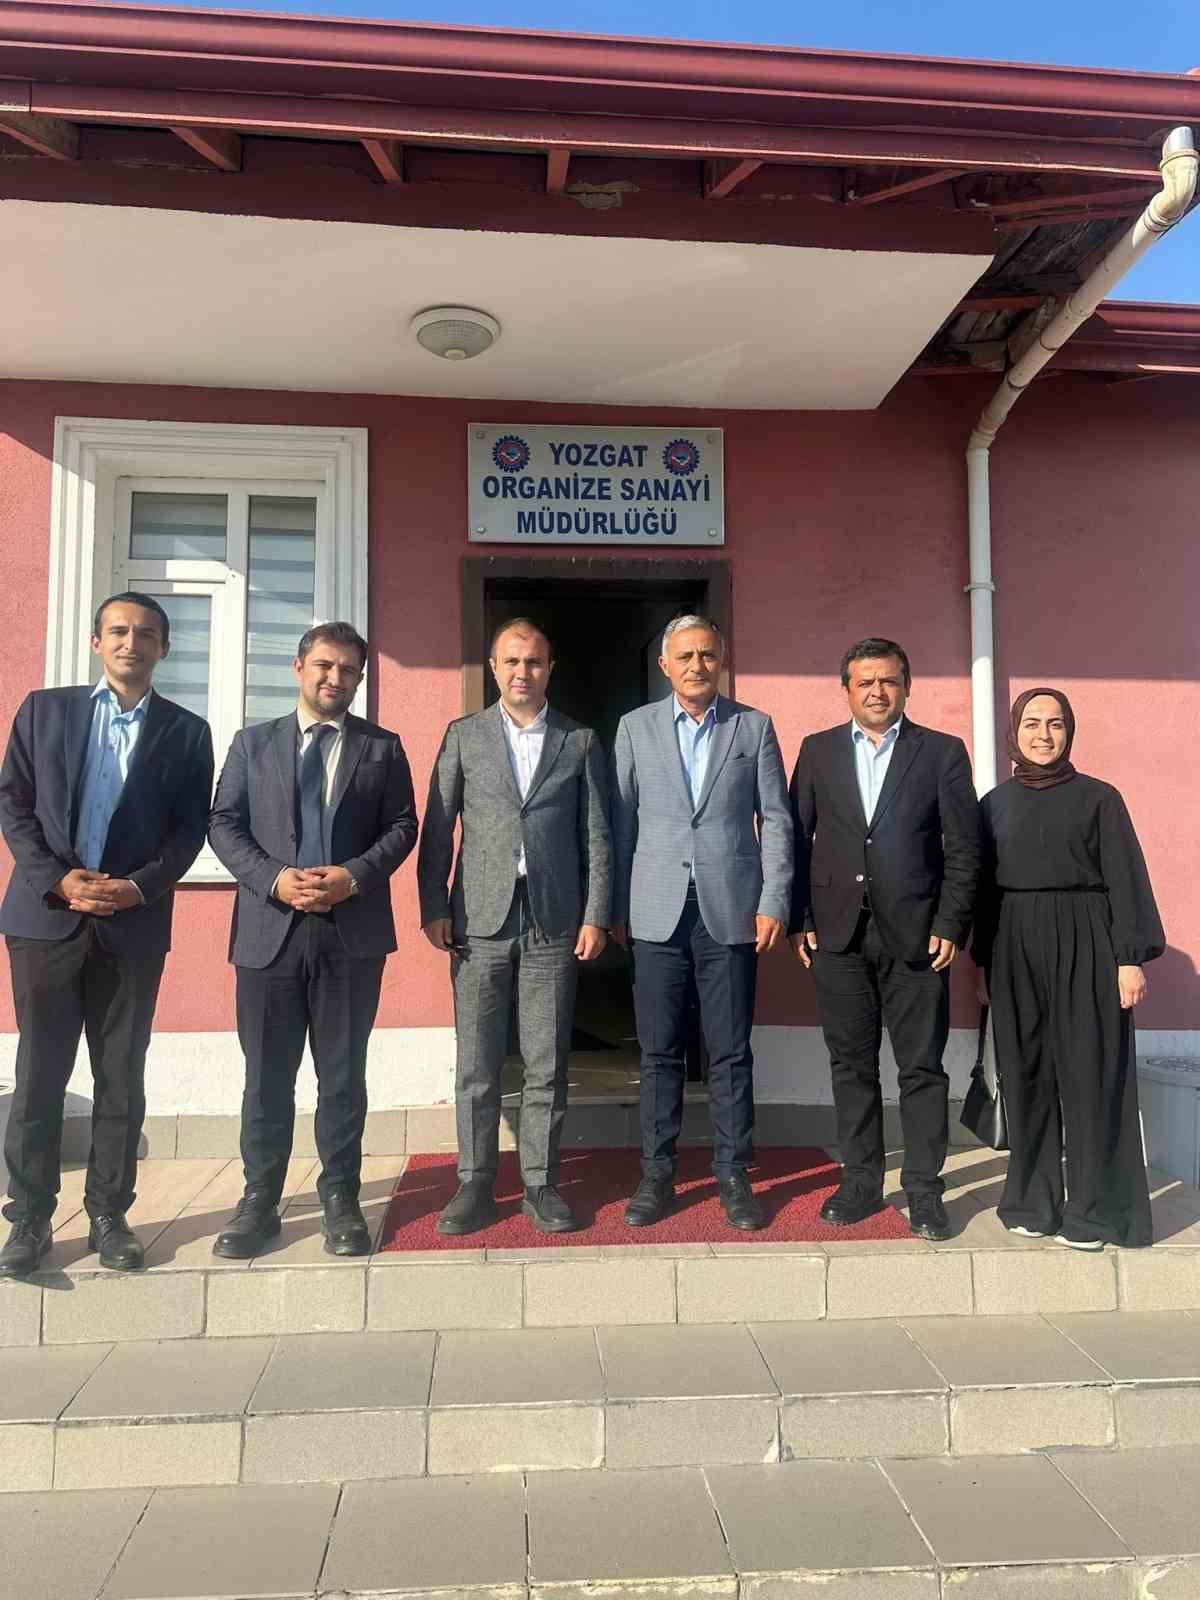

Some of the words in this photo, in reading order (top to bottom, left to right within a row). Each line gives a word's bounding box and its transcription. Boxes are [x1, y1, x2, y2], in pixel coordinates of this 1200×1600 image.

[549, 442, 648, 467] YOZGAT
[482, 472, 612, 500] ORGANİZE
[620, 474, 710, 501] SANAYİ
[517, 507, 677, 535] MÜDÜRLÜĞÜ
